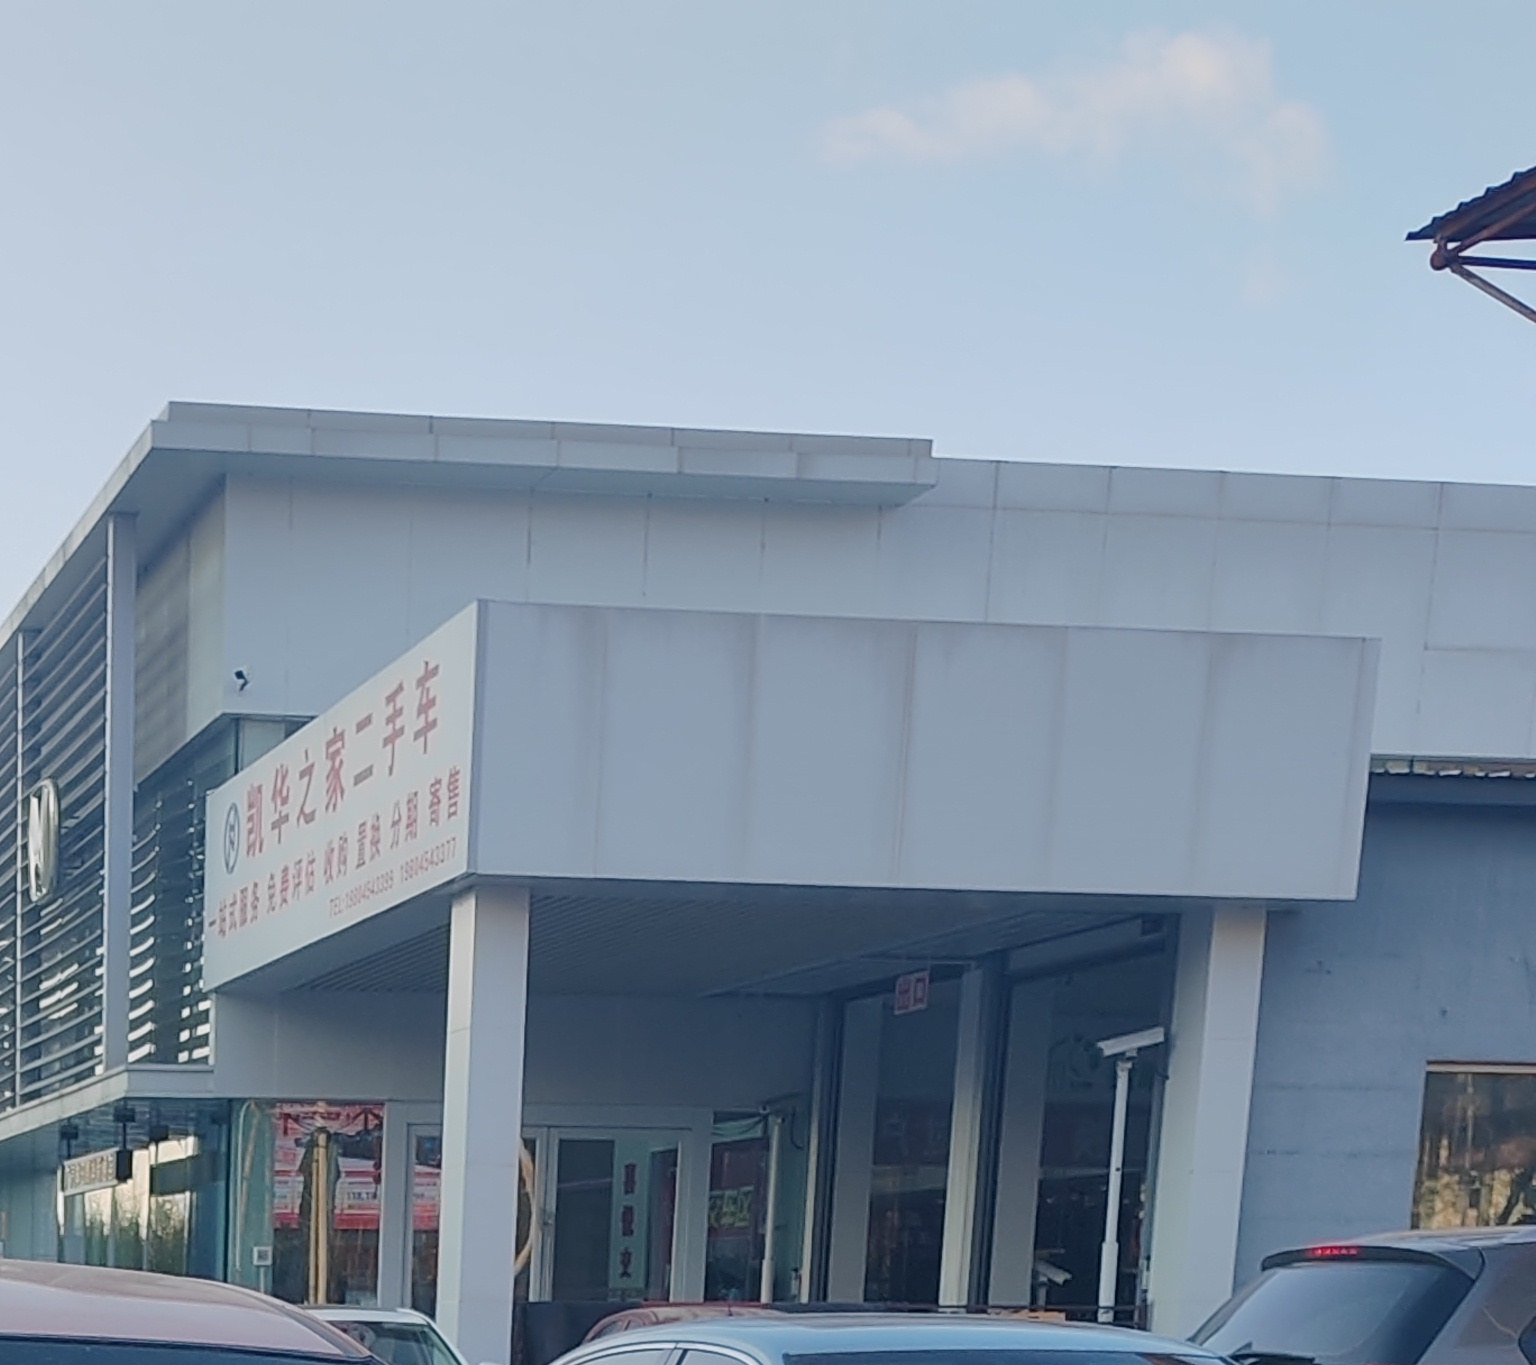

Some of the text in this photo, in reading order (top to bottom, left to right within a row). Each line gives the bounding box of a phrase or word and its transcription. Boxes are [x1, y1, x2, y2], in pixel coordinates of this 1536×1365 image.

[245, 660, 440, 858] 凯华之家二手车
